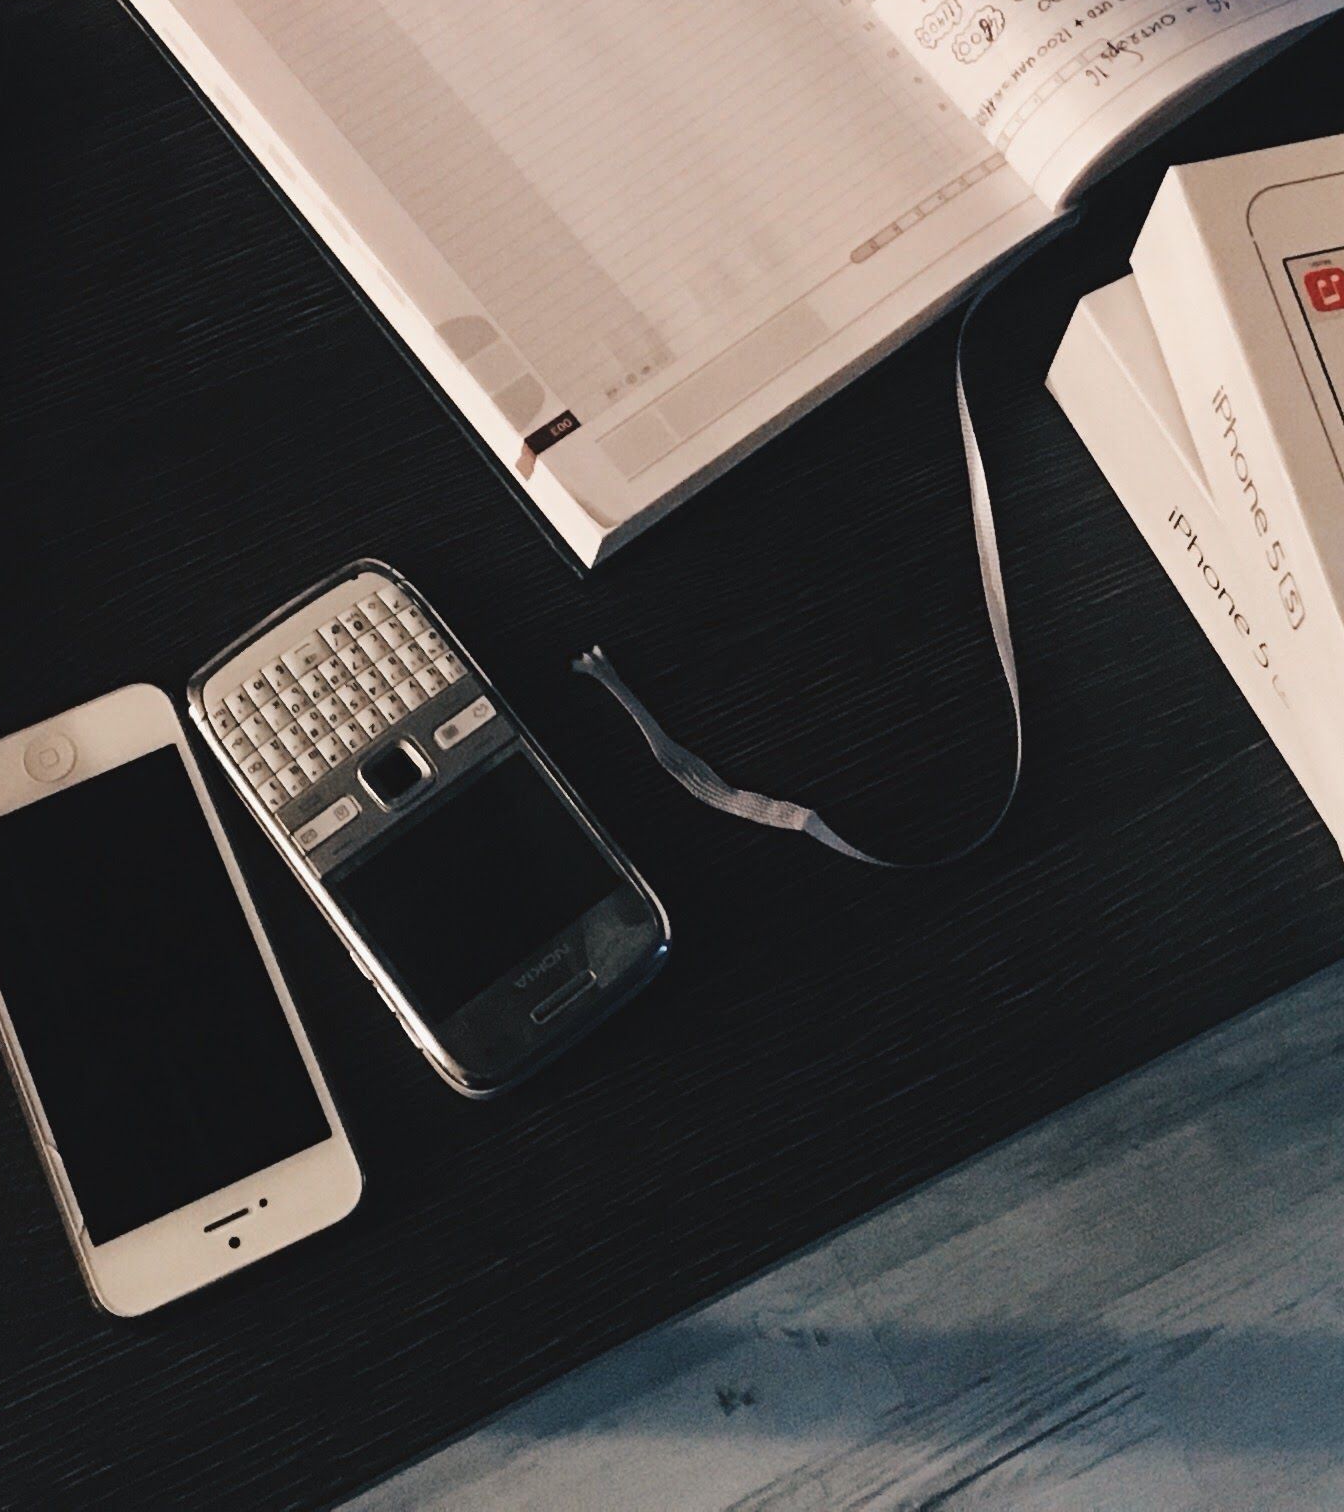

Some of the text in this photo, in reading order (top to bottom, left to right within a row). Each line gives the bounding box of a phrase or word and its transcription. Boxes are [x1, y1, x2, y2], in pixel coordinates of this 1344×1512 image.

[1211, 385, 1268, 537] iPhone
[1168, 506, 1251, 637] iPhone
[511, 941, 571, 989] NOKIA
